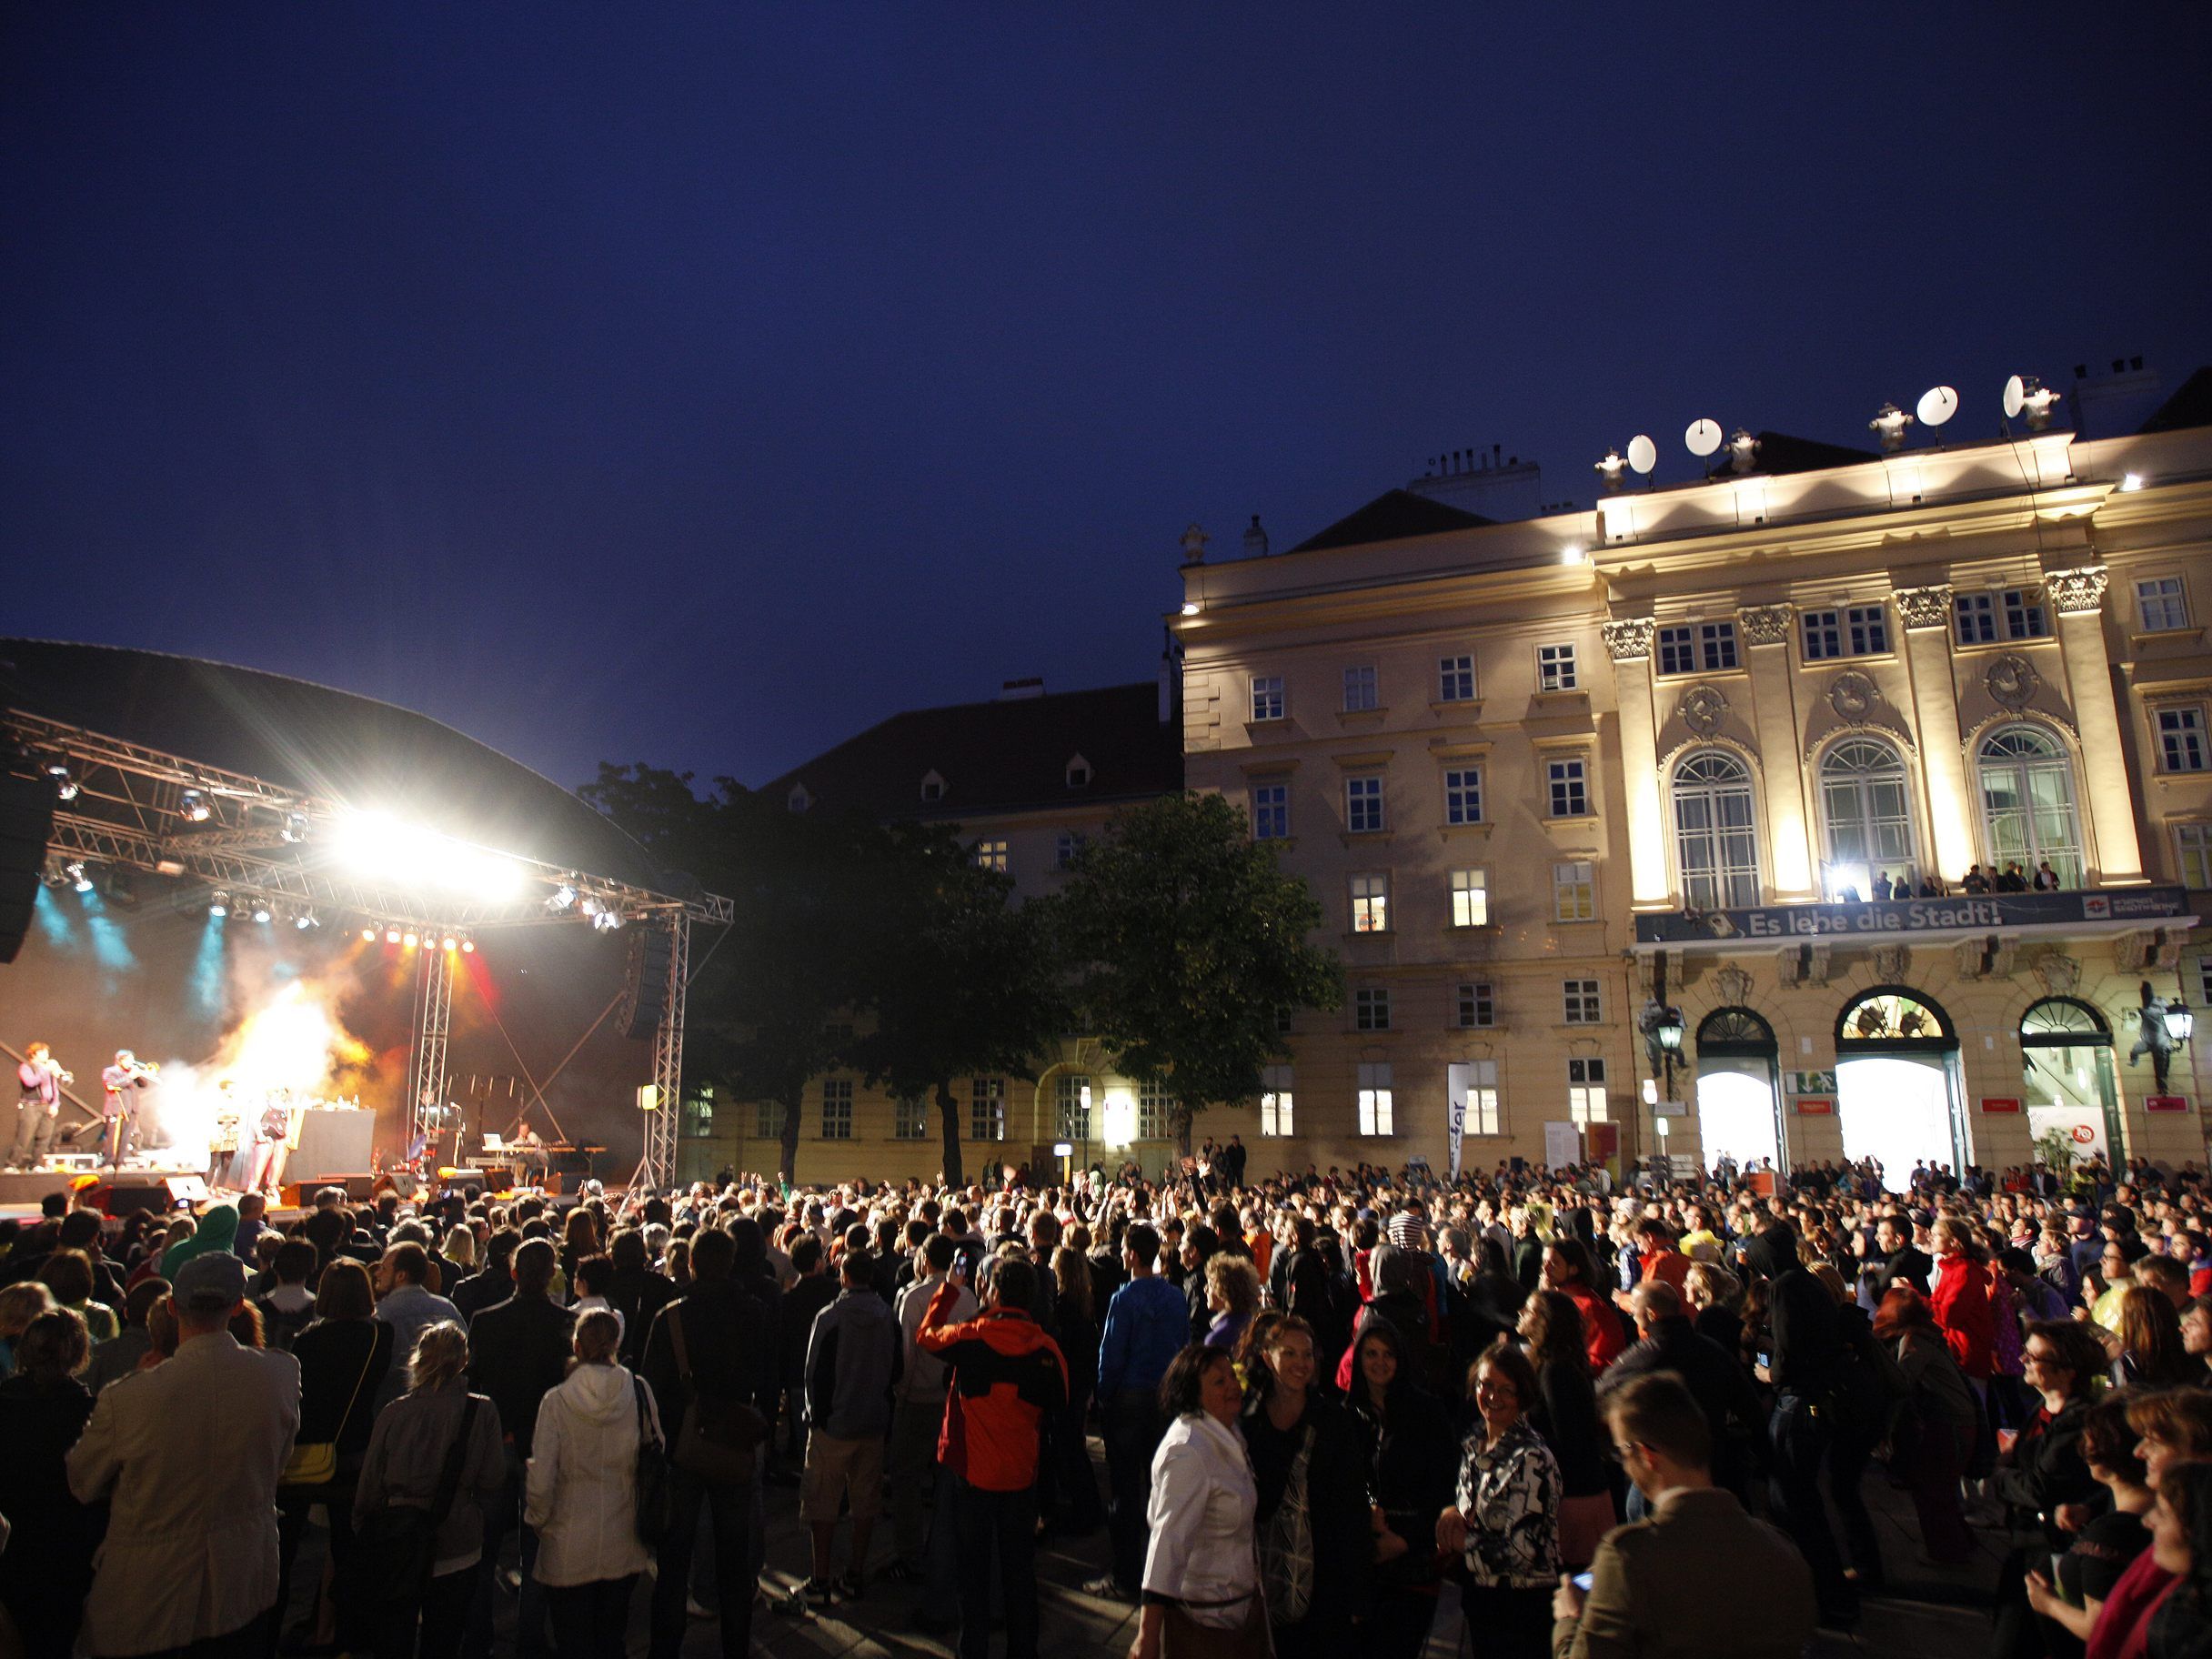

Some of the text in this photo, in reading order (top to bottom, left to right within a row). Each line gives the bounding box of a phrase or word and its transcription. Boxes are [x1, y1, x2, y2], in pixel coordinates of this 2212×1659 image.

[1749, 900, 2003, 936] Es lebe die Stadt!
